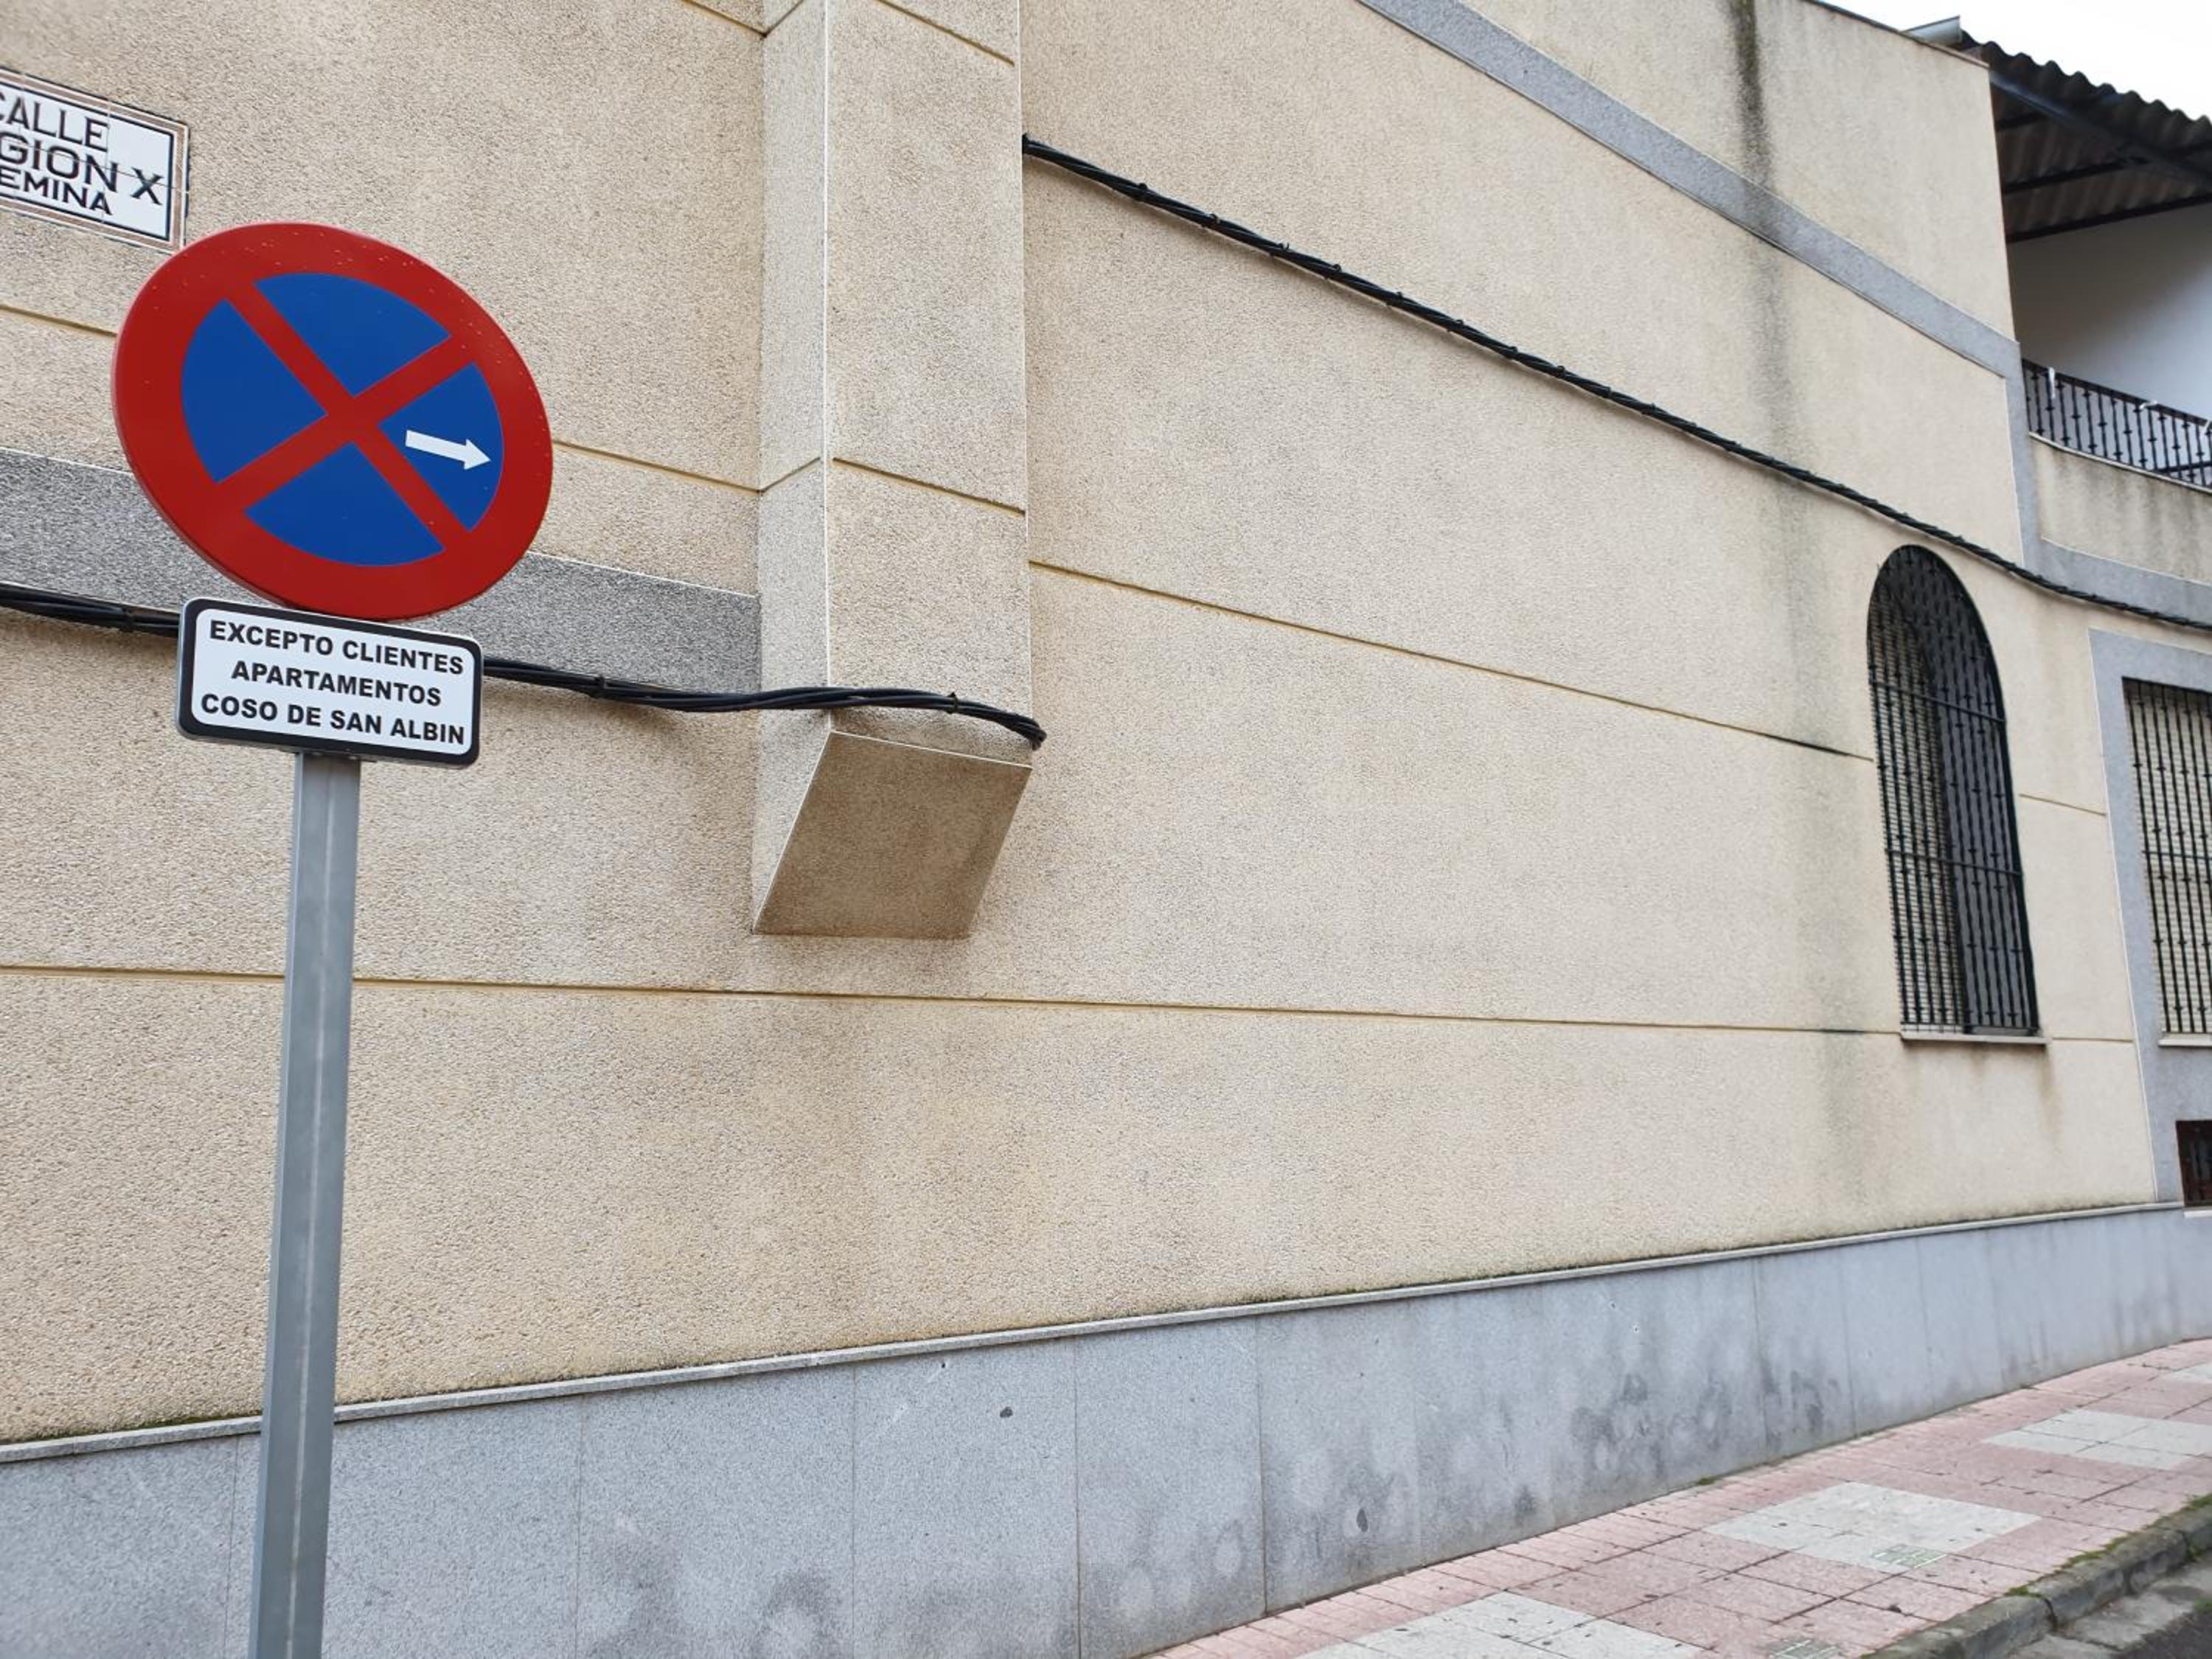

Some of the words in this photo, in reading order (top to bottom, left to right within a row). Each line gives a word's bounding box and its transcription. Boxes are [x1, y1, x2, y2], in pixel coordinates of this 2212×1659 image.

[0, 92, 108, 153] ALLE
[130, 167, 163, 206] X
[209, 619, 333, 655] EXCEPTO
[343, 641, 464, 675] CLIENTES
[231, 661, 441, 706] APARTAMENTOS
[201, 694, 278, 721] COSO
[287, 705, 321, 728] DE
[330, 710, 382, 735] SAN
[390, 719, 465, 745] ALBIN
